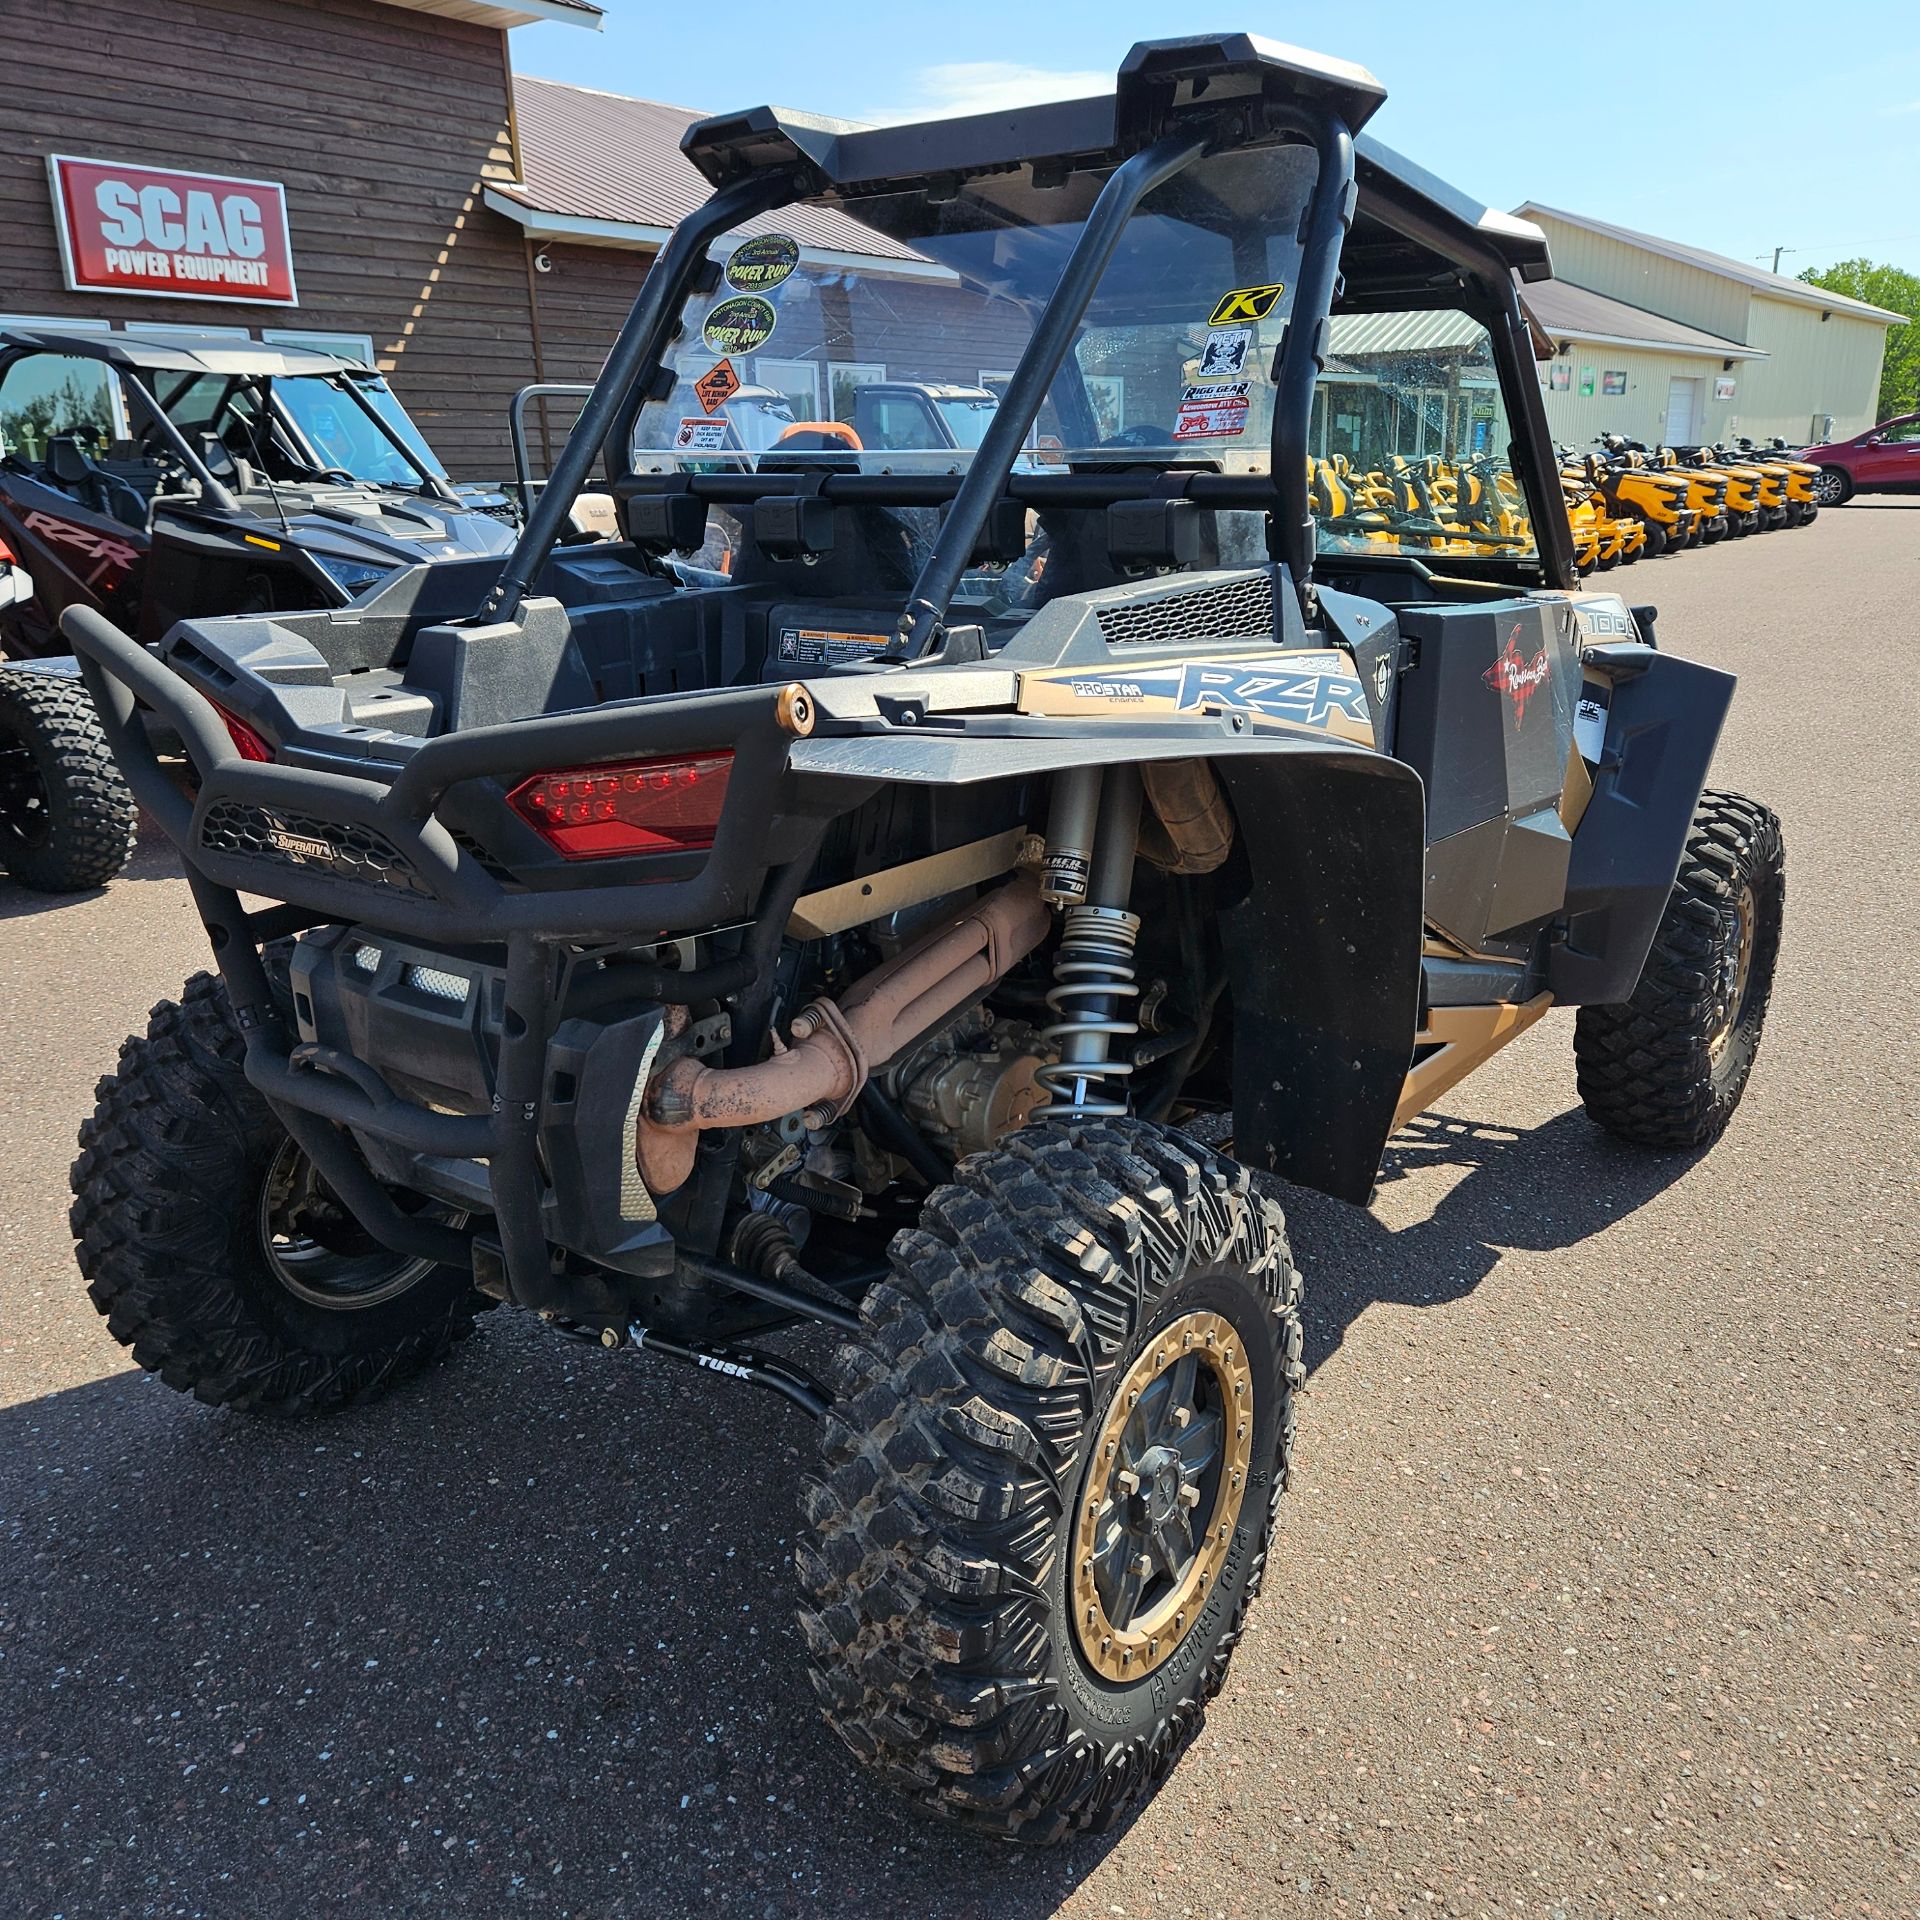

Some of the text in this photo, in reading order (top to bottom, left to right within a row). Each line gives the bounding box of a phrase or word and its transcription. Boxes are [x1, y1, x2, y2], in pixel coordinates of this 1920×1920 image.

[95, 179, 266, 259] SCAG
[104, 247, 269, 287] POWER EQUIPMENT
[729, 264, 791, 281] POKER RUN
[706, 326, 767, 344] POKER RUN
[1213, 332, 1246, 345] YETI
[1184, 382, 1249, 399] RIGG GEAR
[24, 511, 140, 571] RZR
[1297, 656, 1344, 673] POLARIS
[1073, 682, 1143, 698] PROSTAR
[1175, 662, 1372, 724] RZR
[1580, 699, 1601, 714] EPS
[698, 1354, 754, 1380] TUSK
